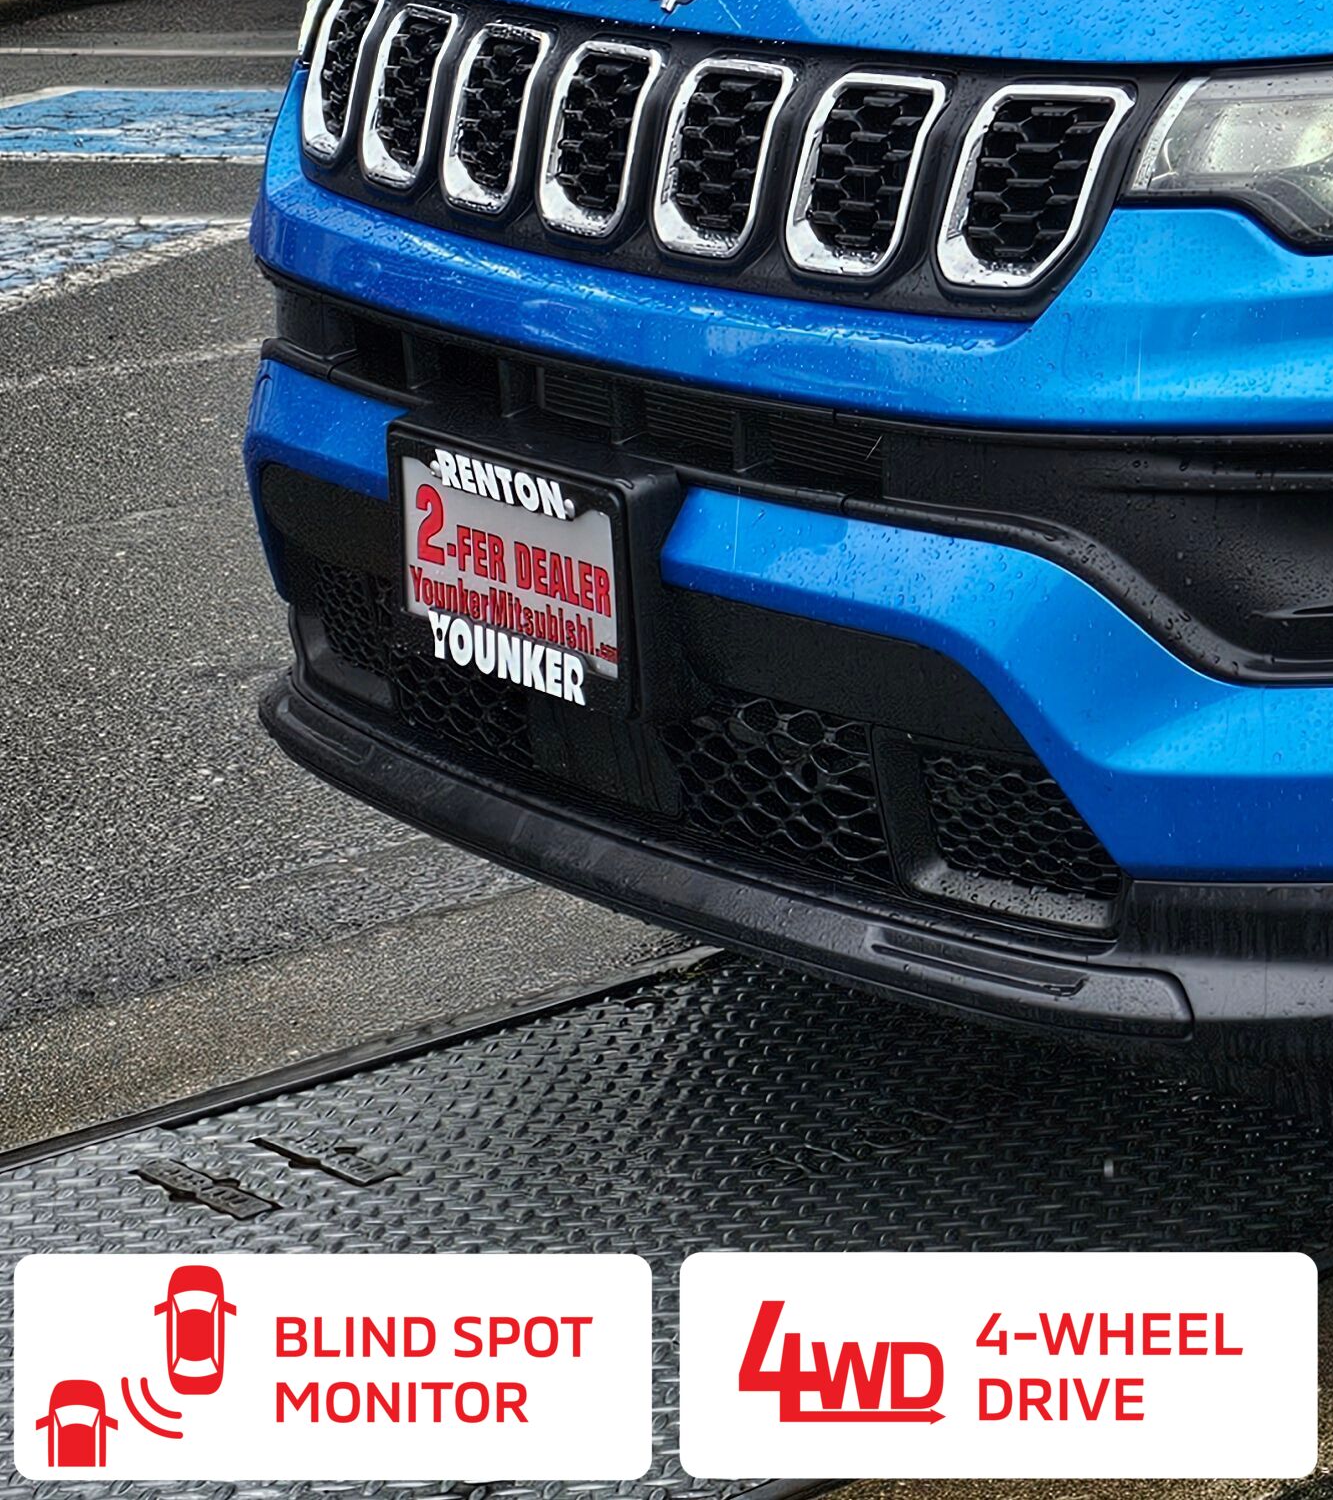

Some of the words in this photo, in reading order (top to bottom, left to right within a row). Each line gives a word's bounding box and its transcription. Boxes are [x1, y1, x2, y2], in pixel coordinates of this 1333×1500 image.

[434, 448, 567, 520] RENTON
[415, 483, 506, 584] 2-FER
[513, 541, 612, 618] DEALER
[428, 608, 586, 707] YOUNKER
